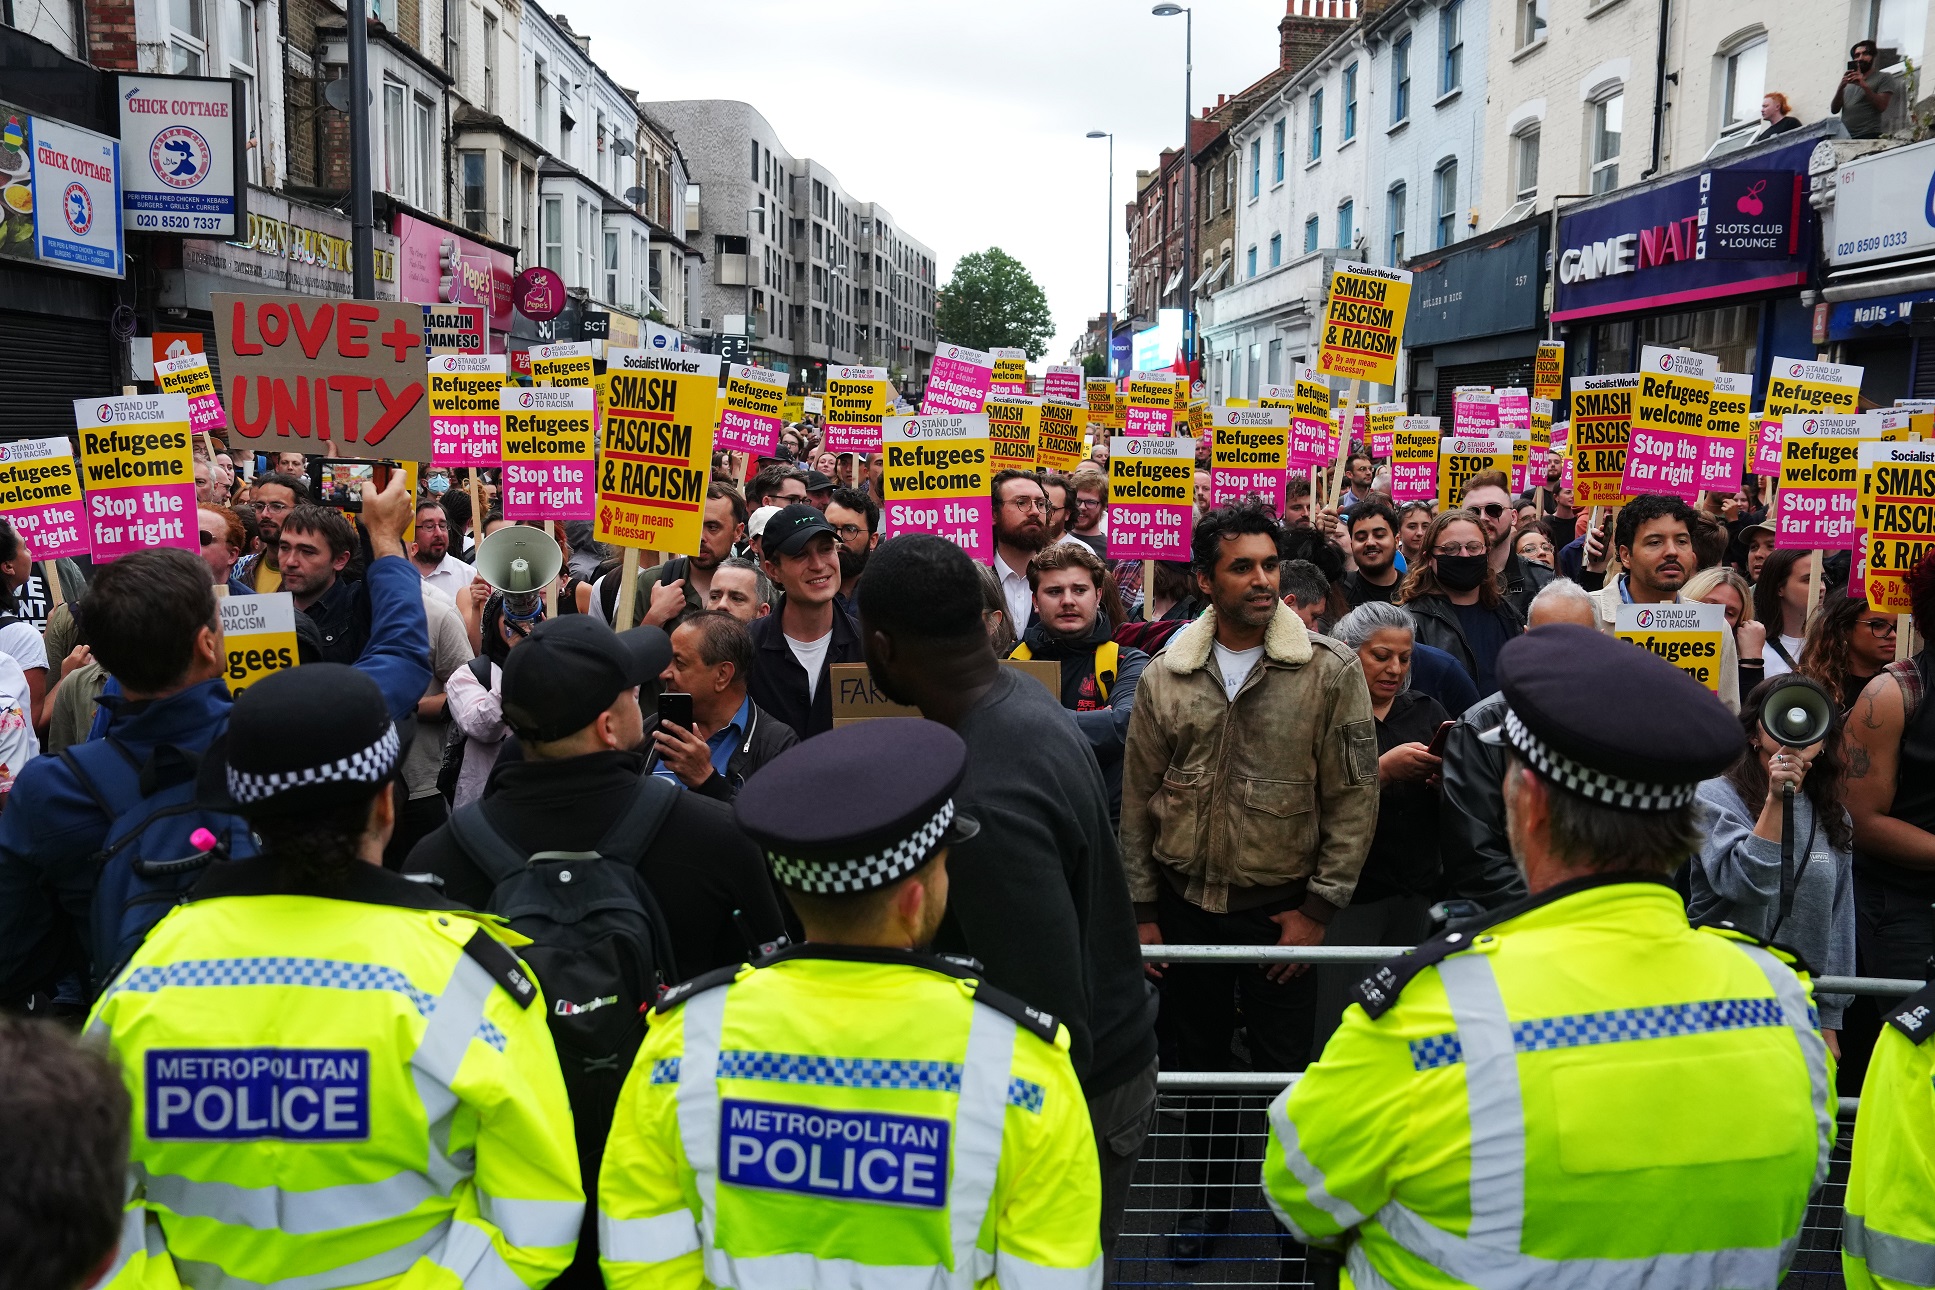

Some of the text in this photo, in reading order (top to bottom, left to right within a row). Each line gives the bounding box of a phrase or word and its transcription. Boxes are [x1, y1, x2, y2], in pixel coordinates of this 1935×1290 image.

[129, 98, 228, 117] CHICK COTTAGE
[38, 147, 111, 183] CHICK COTTAGE
[1841, 172, 1855, 184] 161
[137, 215, 221, 229] 020 8520 7337
[1716, 224, 1782, 234] SLOTS CLUB
[1730, 238, 1776, 248] LOUNGE
[1838, 231, 1908, 256] 020 8509 0333
[1560, 233, 1637, 284] GAME
[464, 262, 489, 296] Pepe's
[1347, 265, 1401, 281] Socialist Worker
[1516, 275, 1527, 286] 157
[1335, 276, 1387, 301] SMASH
[527, 300, 548, 309] Pepe's
[1330, 301, 1394, 328] FASCISM
[1854, 306, 1887, 322] Nails
[1326, 326, 1397, 355] & RACISM
[515, 354, 530, 362] JUS
[1538, 349, 1556, 358] SMASH
[1676, 356, 1693, 365] STAND
[624, 355, 700, 373] Socialist Worker
[936, 358, 950, 368] Say
[958, 363, 974, 374] loud
[1537, 362, 1559, 372] FASCISM
[1685, 367, 1703, 376] RACISM
[934, 367, 947, 378] Say
[956, 372, 976, 383] clear:
[432, 377, 502, 395] Refugees
[609, 375, 677, 412] SMASH
[830, 381, 874, 396] Oppose
[930, 375, 983, 399] Refugees
[1131, 383, 1172, 395] Refugees
[1643, 377, 1710, 405] Refugees
[1772, 382, 1853, 406] Refugees
[114, 401, 159, 412] STAND UP
[433, 395, 500, 410] welcome
[829, 396, 872, 411] Tommy
[928, 391, 977, 411] welcome
[1130, 396, 1170, 405] welcome
[1576, 392, 1630, 416] SMASH
[115, 410, 165, 421] TO RACISM
[232, 375, 425, 446] UNITY
[829, 410, 882, 422] Robinson
[1041, 405, 1072, 420] SMASH
[1129, 409, 1167, 420] Stop the
[1640, 404, 1702, 427] welcome
[433, 420, 498, 438] Stop the
[505, 415, 589, 436] Refugees
[829, 426, 878, 436] Stop fascists
[1040, 421, 1078, 437] FASCISM
[85, 431, 186, 456] Refugees
[506, 437, 586, 454] welcome
[606, 418, 692, 458] FASCISM
[864, 437, 882, 446] right
[1046, 438, 1081, 453] RACISM
[1216, 430, 1284, 448] Refugees
[1396, 434, 1436, 447] Refugees
[1634, 434, 1697, 460] Stop the
[888, 446, 985, 470] Refugees
[1216, 448, 1280, 463] welcome
[1396, 447, 1433, 458] welcome
[1891, 450, 1934, 462] Socialist
[88, 458, 183, 481] welcome
[507, 465, 583, 486] Stop the
[1114, 461, 1190, 480] Refugees
[1394, 465, 1431, 478] Stop the
[1630, 458, 1693, 486] far right
[602, 460, 703, 502] & RACISM
[890, 470, 981, 491] welcome
[1114, 481, 1185, 498] welcome
[92, 491, 183, 520] Stop the
[508, 487, 582, 508] far right
[1783, 493, 1827, 513] Stop
[615, 507, 674, 528] By any means
[891, 503, 979, 529] Stop the
[1112, 508, 1182, 528] Stop the
[94, 517, 184, 545] far right
[614, 525, 656, 544] necessary
[1112, 529, 1179, 548] far right
[1912, 1005, 1930, 1019] CE
[157, 1057, 359, 1080] METROPOLITAN
[157, 1085, 359, 1132] POLICE
[731, 1107, 938, 1148] METROPOLITAN
[729, 1135, 937, 1198] POLICE
